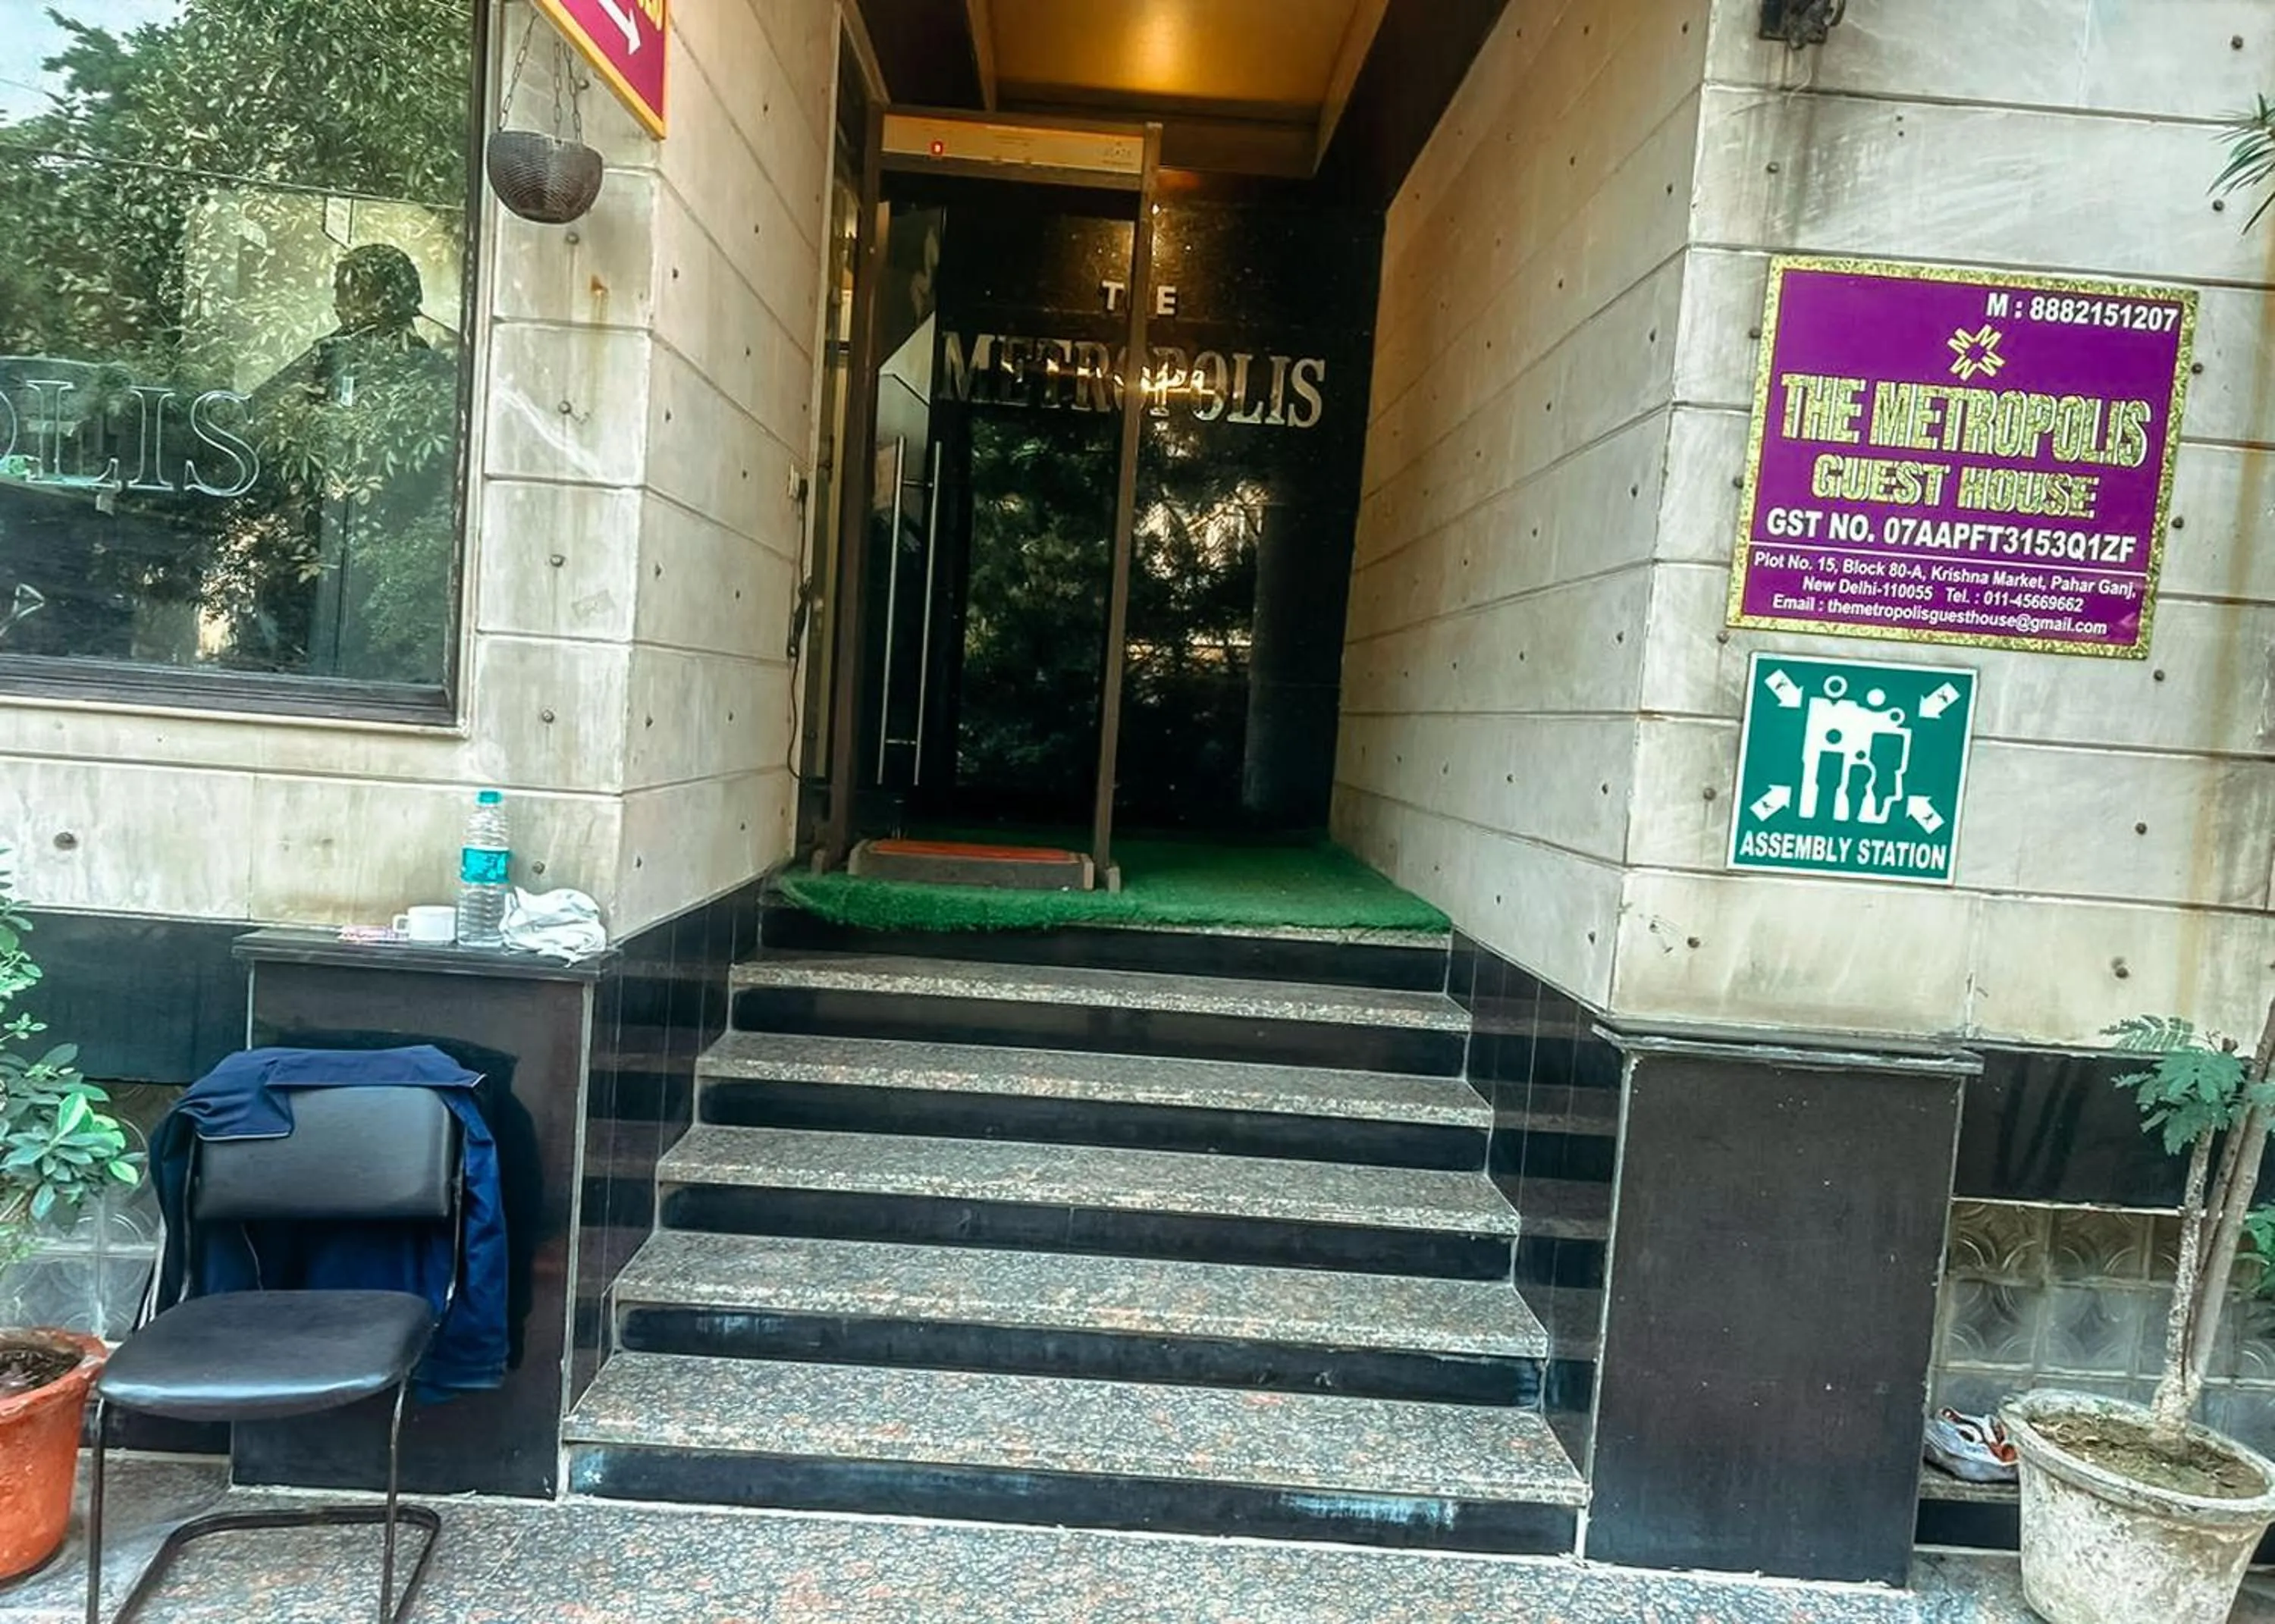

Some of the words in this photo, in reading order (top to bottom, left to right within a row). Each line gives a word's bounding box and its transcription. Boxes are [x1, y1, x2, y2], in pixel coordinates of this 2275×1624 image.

[1101, 280, 1177, 315] TE
[1986, 293, 2009, 318] M
[2029, 296, 2179, 332] 8882151207
[0, 379, 260, 497] LIS
[1781, 373, 1867, 444] THE
[1869, 381, 2152, 468] METROPOLIS
[1812, 453, 1951, 506] GUEST
[1956, 466, 2100, 519] HOUSE
[1767, 507, 1823, 538] GST
[1828, 512, 1875, 543] NO.
[1884, 517, 2137, 563] 07AAPFT3153Q1ZF
[1754, 551, 1784, 568] Plot
[1788, 555, 1812, 570] No.
[1818, 556, 1839, 574] 15,
[1843, 559, 1886, 576] Block
[1889, 562, 1927, 582] 80-A,
[1931, 566, 1988, 585] Krishna
[1992, 570, 2046, 591] Market,
[2051, 575, 2095, 594] Pahar
[1803, 575, 1836, 593] New
[1839, 578, 1934, 600] Delhi-110055
[1945, 587, 1970, 604] Tel.
[1772, 594, 1815, 611] Email
[1828, 599, 2108, 635] themetropolisguesthouse@gmail.com
[1740, 830, 1853, 863] ASSEMBLY
[1857, 838, 1947, 870] STATION
